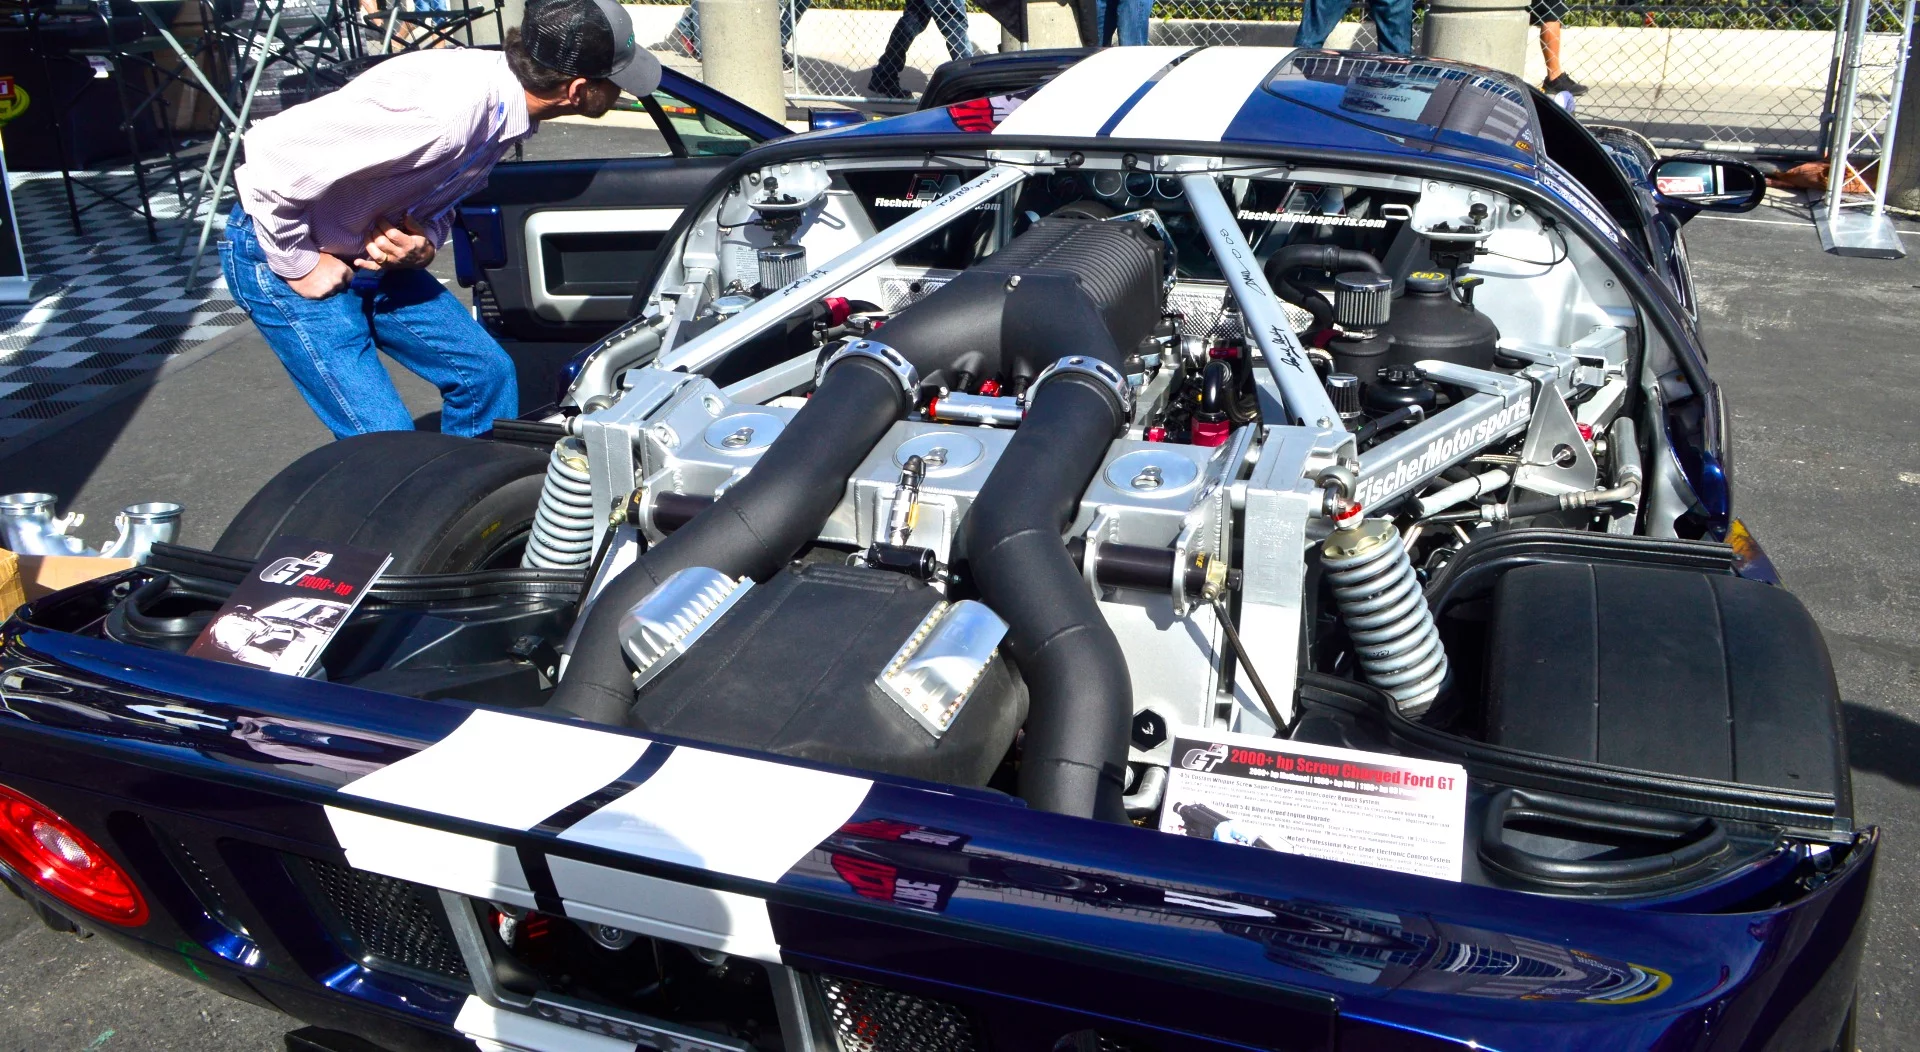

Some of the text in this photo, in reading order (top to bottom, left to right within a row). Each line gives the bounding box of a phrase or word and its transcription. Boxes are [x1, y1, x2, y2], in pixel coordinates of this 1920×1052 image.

[1237, 210, 1387, 229] FischerMotorsports.com
[1354, 395, 1530, 506] FischerMotorsports
[259, 556, 326, 586] GT
[297, 576, 354, 596] 2000+ hp
[1231, 749, 1454, 790] 2000+ hp Screw Charged Ford GT
[1406, 852, 1428, 860] Control
[1429, 855, 1450, 864] System
